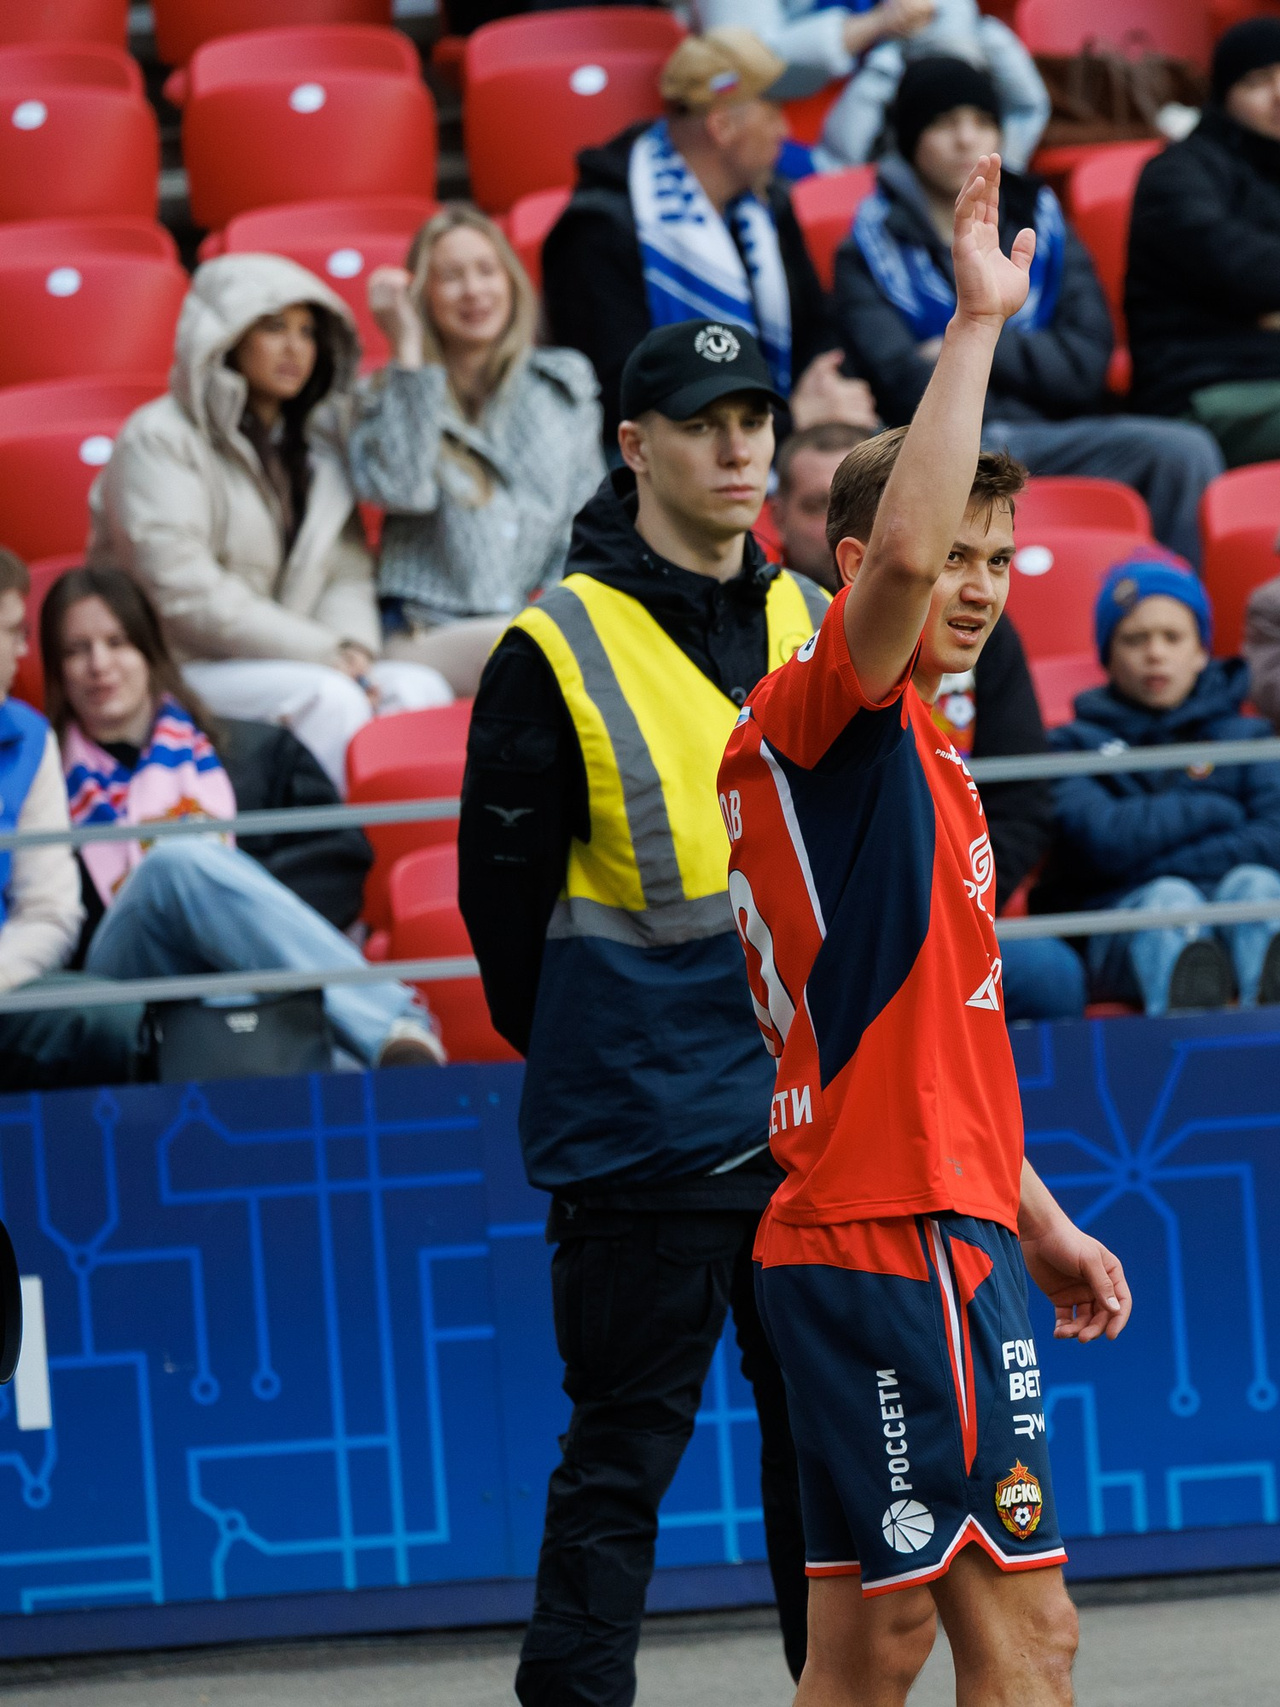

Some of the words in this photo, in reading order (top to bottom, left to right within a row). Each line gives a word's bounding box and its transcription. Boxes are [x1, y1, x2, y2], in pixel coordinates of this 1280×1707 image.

[768, 1084, 813, 1139] ЕТИ
[1002, 1339, 1037, 1370] FON
[1009, 1369, 1041, 1401] BET
[876, 1368, 913, 1492] РОССЕТИ
[998, 1483, 1041, 1508] ЦСКА
